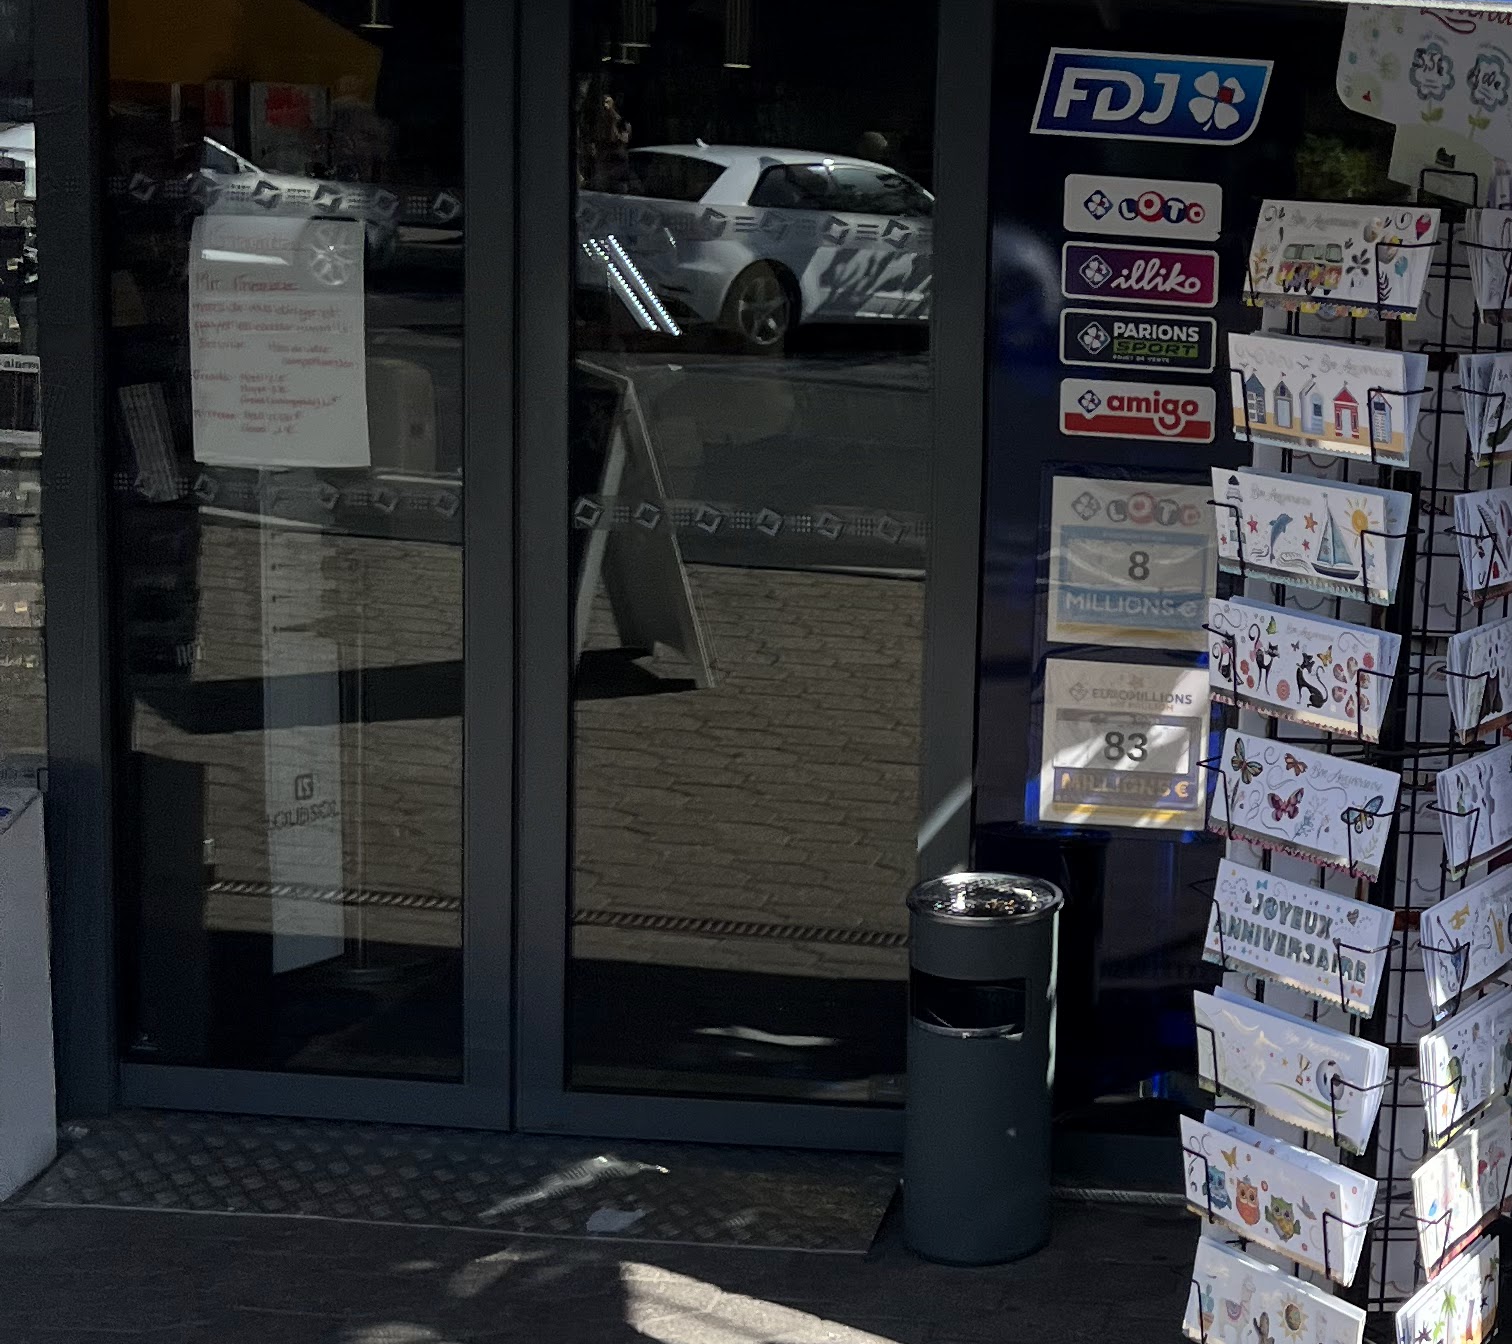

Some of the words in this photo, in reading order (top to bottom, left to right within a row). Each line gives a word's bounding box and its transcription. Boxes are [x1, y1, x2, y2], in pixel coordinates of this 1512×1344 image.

[1053, 67, 1181, 125] FDJ
[1118, 191, 1206, 224] LOTO
[1110, 258, 1201, 295] illiko
[1113, 322, 1199, 342] PARIONS
[1116, 340, 1197, 356] SPORT
[1106, 391, 1199, 430] amigo
[1106, 492, 1200, 526] LOTO
[1128, 551, 1150, 581] 8
[1065, 593, 1174, 616] MILLIONS
[1103, 731, 1149, 762] 83
[1175, 781, 1190, 798] €
[1251, 892, 1334, 940] JOYEUX
[1212, 911, 1368, 984] ANNIVERSAIRE
